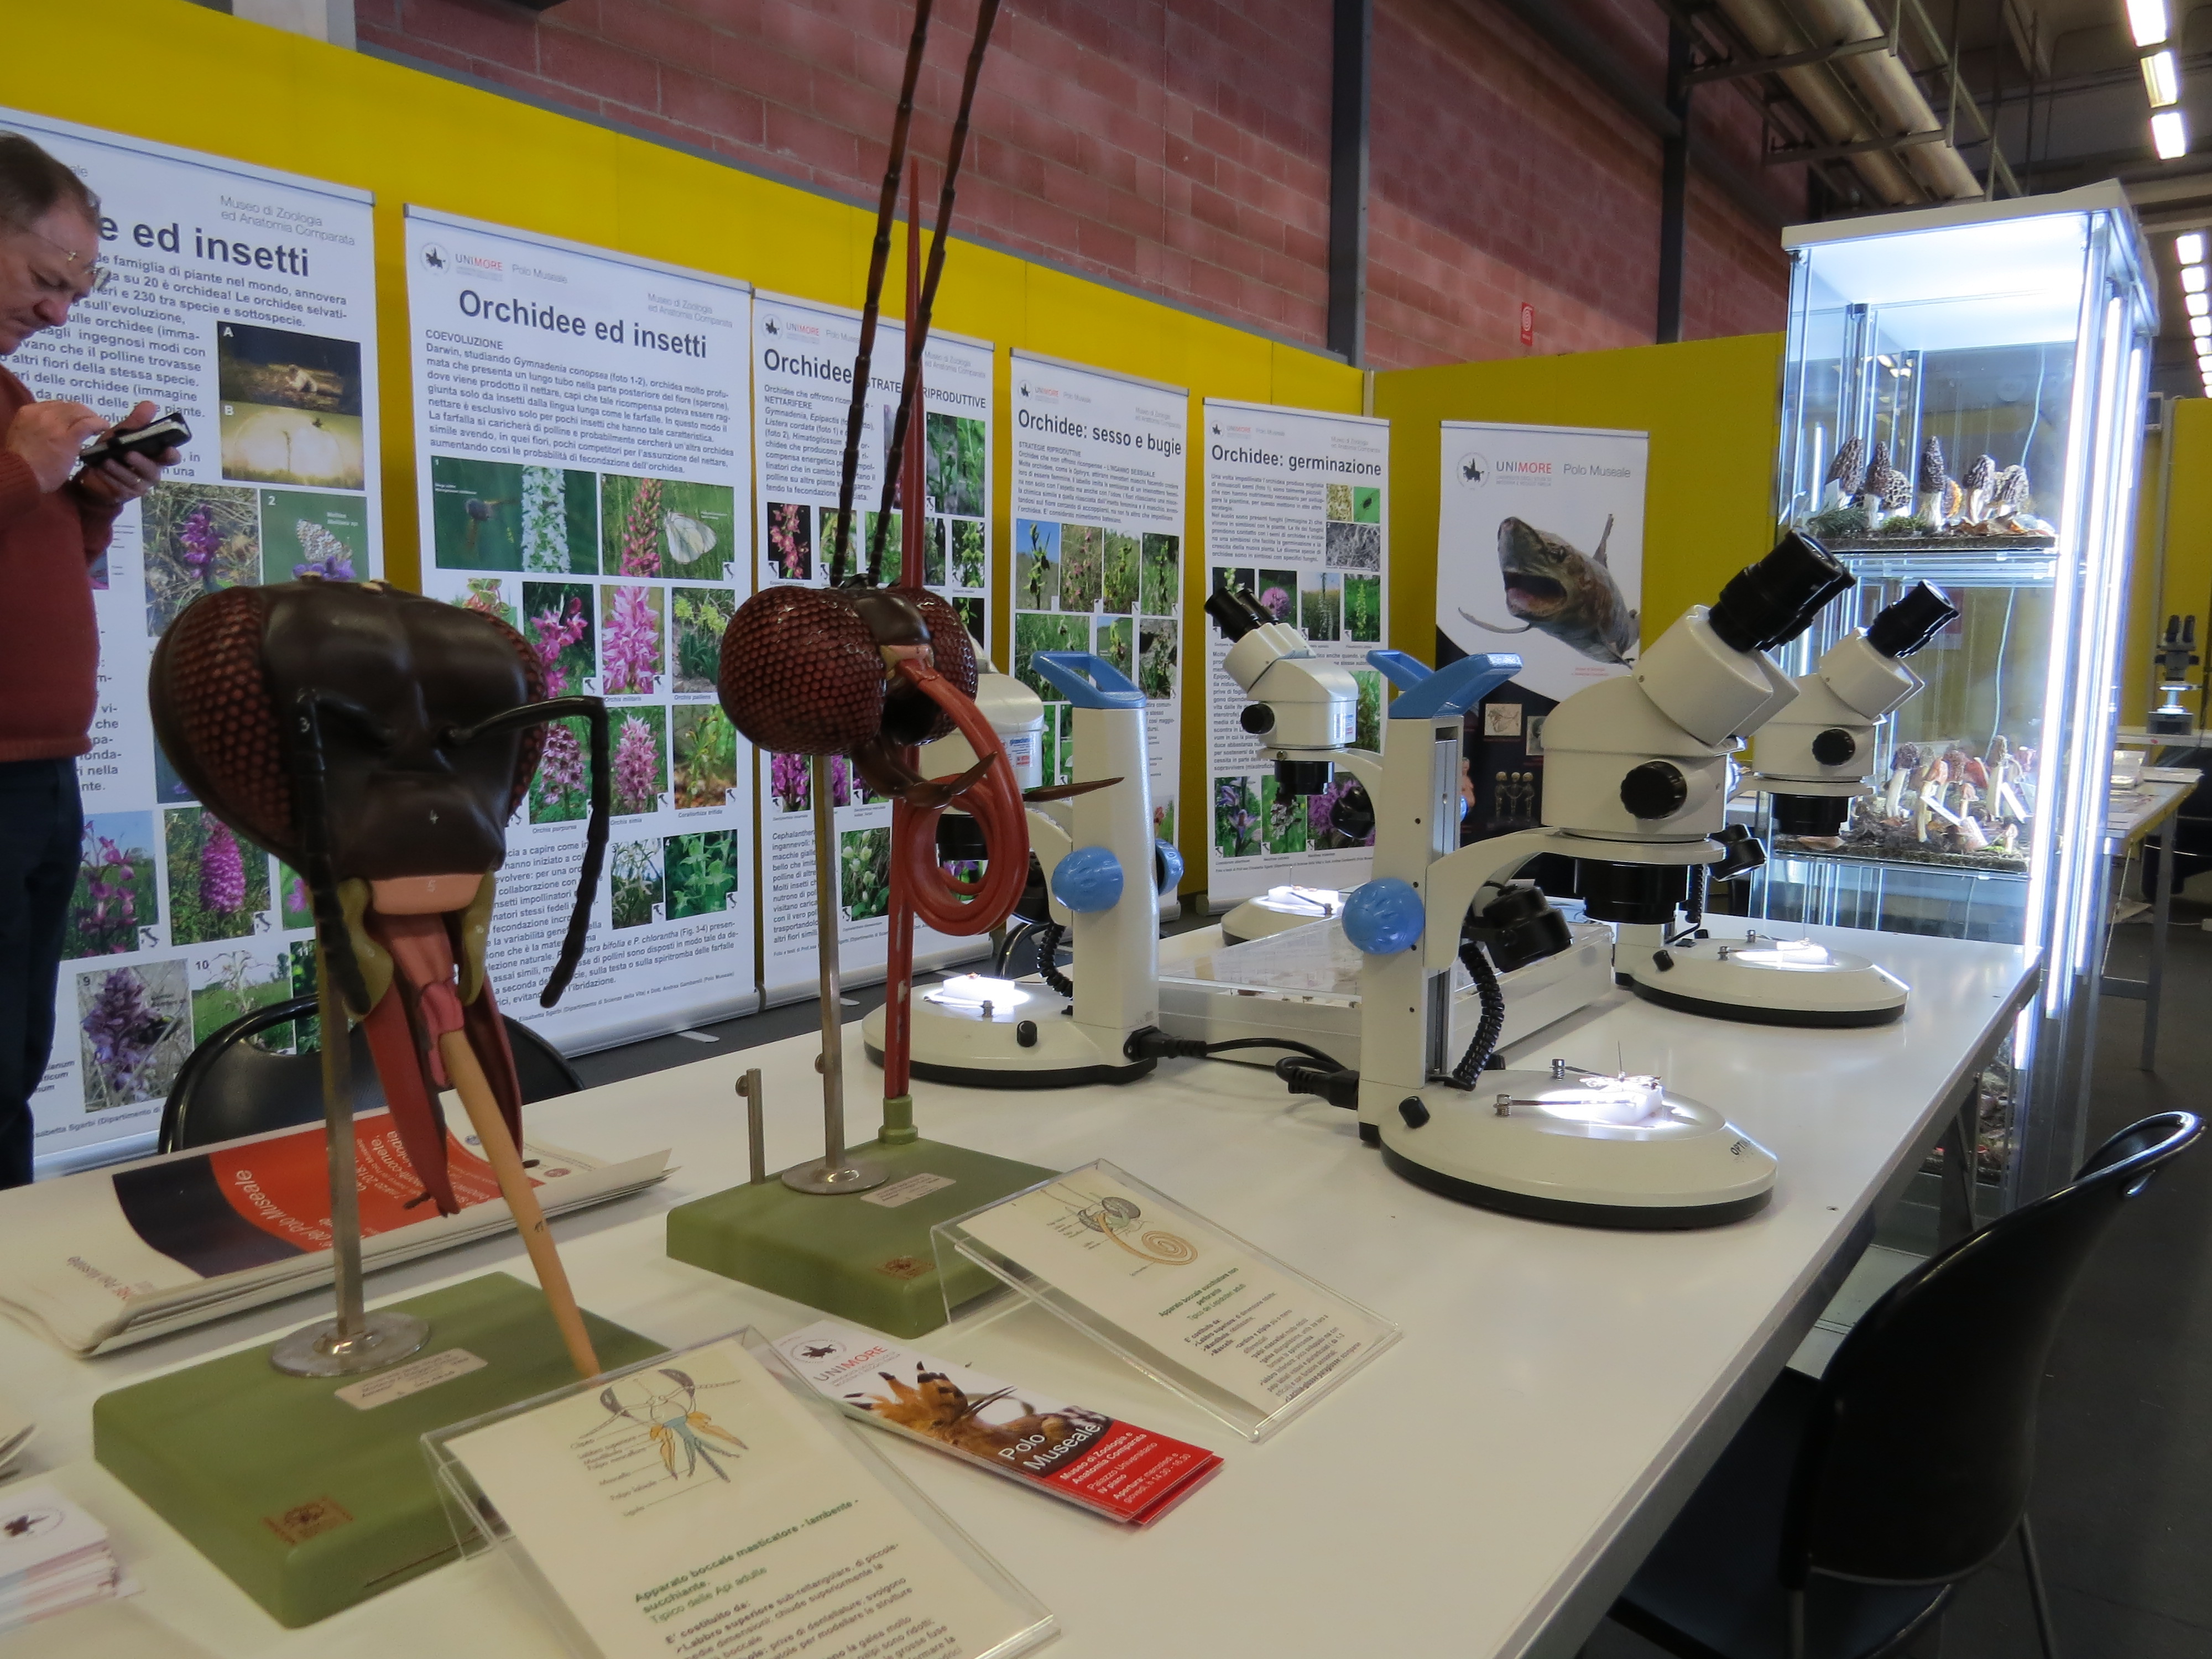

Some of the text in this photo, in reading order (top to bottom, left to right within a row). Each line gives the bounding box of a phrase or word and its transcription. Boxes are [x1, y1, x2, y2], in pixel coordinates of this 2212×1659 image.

[220, 195, 322, 226] Museo di Zoologia
[220, 211, 355, 246] ed Anatomia Comparata
[133, 223, 180, 254] ed
[195, 229, 308, 277] insetti
[455, 253, 503, 271] UNIMORE
[113, 254, 346, 305] famiglia di piante nel mondo, annovera
[512, 264, 568, 284] Polo Museale
[121, 290, 305, 327] e 230 tra specie e sottospecie.
[123, 274, 347, 319] su 20 è orchidea! Le orchidee selvati-
[84, 300, 185, 325] sull'evoluzione,
[459, 290, 706, 358] Orchidee ed insetti
[95, 318, 200, 340] orchidee (imma-
[223, 327, 233, 337] A
[425, 329, 503, 350] COEVOLUZIONE
[786, 322, 820, 336] UNIMORE
[59, 343, 201, 372] che il polline trovasse
[79, 331, 205, 357] ingegnosi modi con
[12, 353, 199, 387] altri fiori della stessa specie.
[426, 343, 729, 398] Darwin, studiando Gymnadenia conopsea (foto 1-2), orchidea molto profu-
[764, 349, 852, 383] Orchidee
[34, 372, 197, 401] delle orchidee (immagine
[36, 389, 129, 409] da quelli delle
[426, 358, 450, 368] mata
[452, 361, 469, 371] che
[471, 364, 512, 377] presenta
[529, 371, 553, 384] lungo
[554, 377, 574, 387] tubo
[576, 380, 596, 390] nella
[597, 384, 617, 394] parte
[618, 388, 660, 400] posteriore
[661, 393, 674, 401] del
[675, 394, 691, 404] fiore
[693, 397, 729, 411] (sperone),
[923, 387, 986, 408] RIPRODUTTIVE
[165, 404, 205, 419] piante.
[225, 406, 233, 415] B
[764, 395, 812, 410] NETTARIFERE
[1018, 409, 1181, 457] Orchidee: sesso e bugie
[173, 467, 195, 476] una
[1212, 444, 1381, 476] Orchidee: germinazione
[1496, 461, 1552, 474] UNIMORE
[1563, 463, 1631, 478] Polo Museale
[268, 496, 275, 505] 2
[88, 765, 118, 775] nella
[171, 813, 179, 822] 7
[602, 940, 625, 951] bifolia
[641, 931, 679, 943] chlorantha
[680, 927, 694, 938] (Fig.
[695, 924, 708, 933] 3-4)
[709, 921, 735, 932] presen-
[195, 960, 208, 970] 10
[84, 976, 90, 986] 9
[234, 1170, 288, 1220] Museale
[813, 1346, 888, 1381] UNIMORE
[998, 1434, 1045, 1460] Polo
[1023, 1423, 1101, 1470] Museale
[1060, 1461, 1088, 1480] Museo
[1088, 1454, 1095, 1463] di
[1094, 1436, 1127, 1459] Zoologia
[1072, 1433, 1147, 1484] Anatomia Comparata
[1087, 1442, 1157, 1490] Palazzo Universitario
[1098, 1474, 1127, 1494] IV piano
[635, 1501, 853, 1603] Apparato boccale masticatore lambente
[643, 1581, 711, 1614] succhiante.
[649, 1567, 767, 1624] Tipico delle Api adulte
[682, 1629, 722, 1651] Labbro
[724, 1603, 775, 1631] superiore
[855, 1558, 864, 1567] di
[665, 1600, 750, 1645] E' costituito da:
